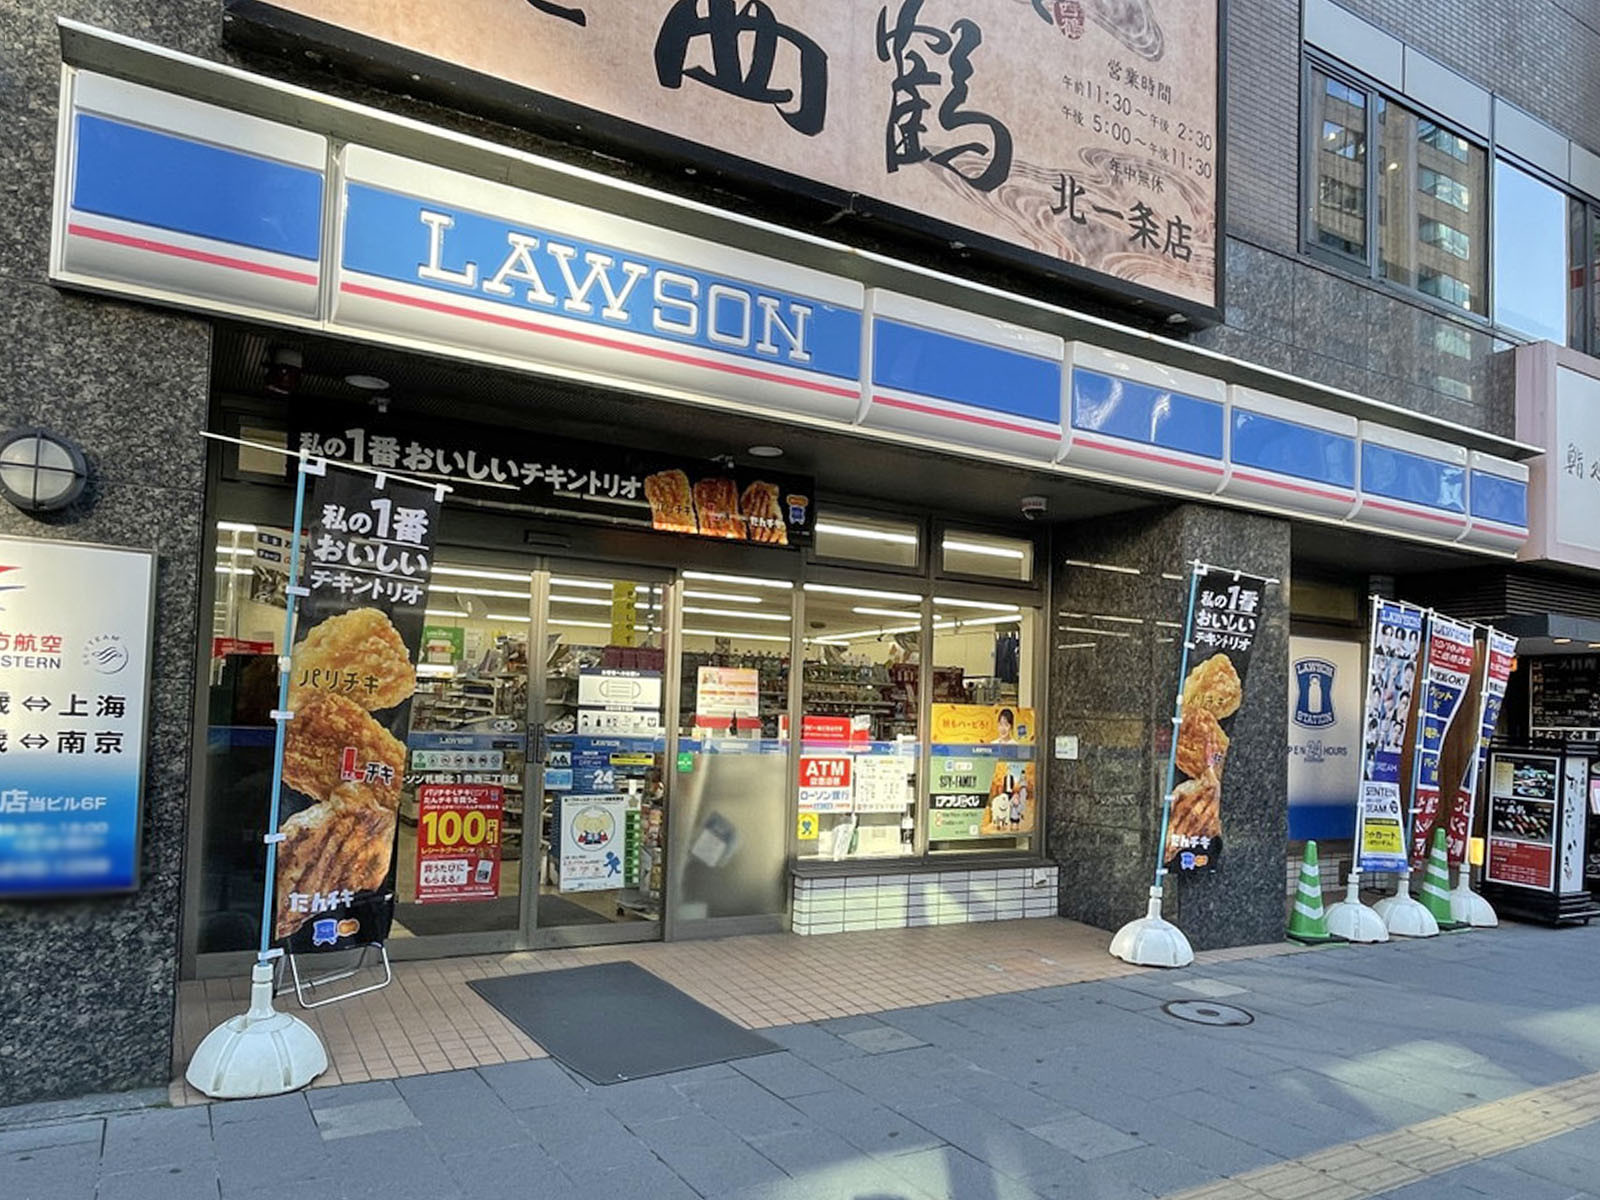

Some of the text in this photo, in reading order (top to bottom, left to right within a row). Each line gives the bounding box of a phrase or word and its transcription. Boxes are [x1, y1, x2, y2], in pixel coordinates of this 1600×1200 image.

[1108, 59, 1172, 105] 営業時間
[1109, 157, 1165, 195] 年中無休
[1051, 173, 1193, 263] 北一条店
[417, 207, 814, 363] LAWSON
[321, 498, 429, 544] 私の1番
[313, 533, 428, 575] おいしい
[310, 570, 424, 605] チキントリオ
[1201, 585, 1259, 611] 私の1番
[1196, 609, 1256, 632] おいしい
[1195, 632, 1251, 651] チキントリオ
[1, 655, 61, 669] STERN
[299, 668, 379, 694] パリチキ
[58, 693, 126, 718] 上海
[1297, 711, 1333, 725] STATION
[57, 730, 124, 754] 南京
[1323, 746, 1348, 756] HOURS
[341, 746, 395, 785] Lチキ
[593, 770, 615, 785] 24
[806, 761, 844, 776] ATM
[800, 790, 849, 801] ローソン銀行
[1171, 834, 1211, 849] たんチキ
[423, 862, 465, 873] 買うたびに
[288, 888, 354, 912] たんチキ
